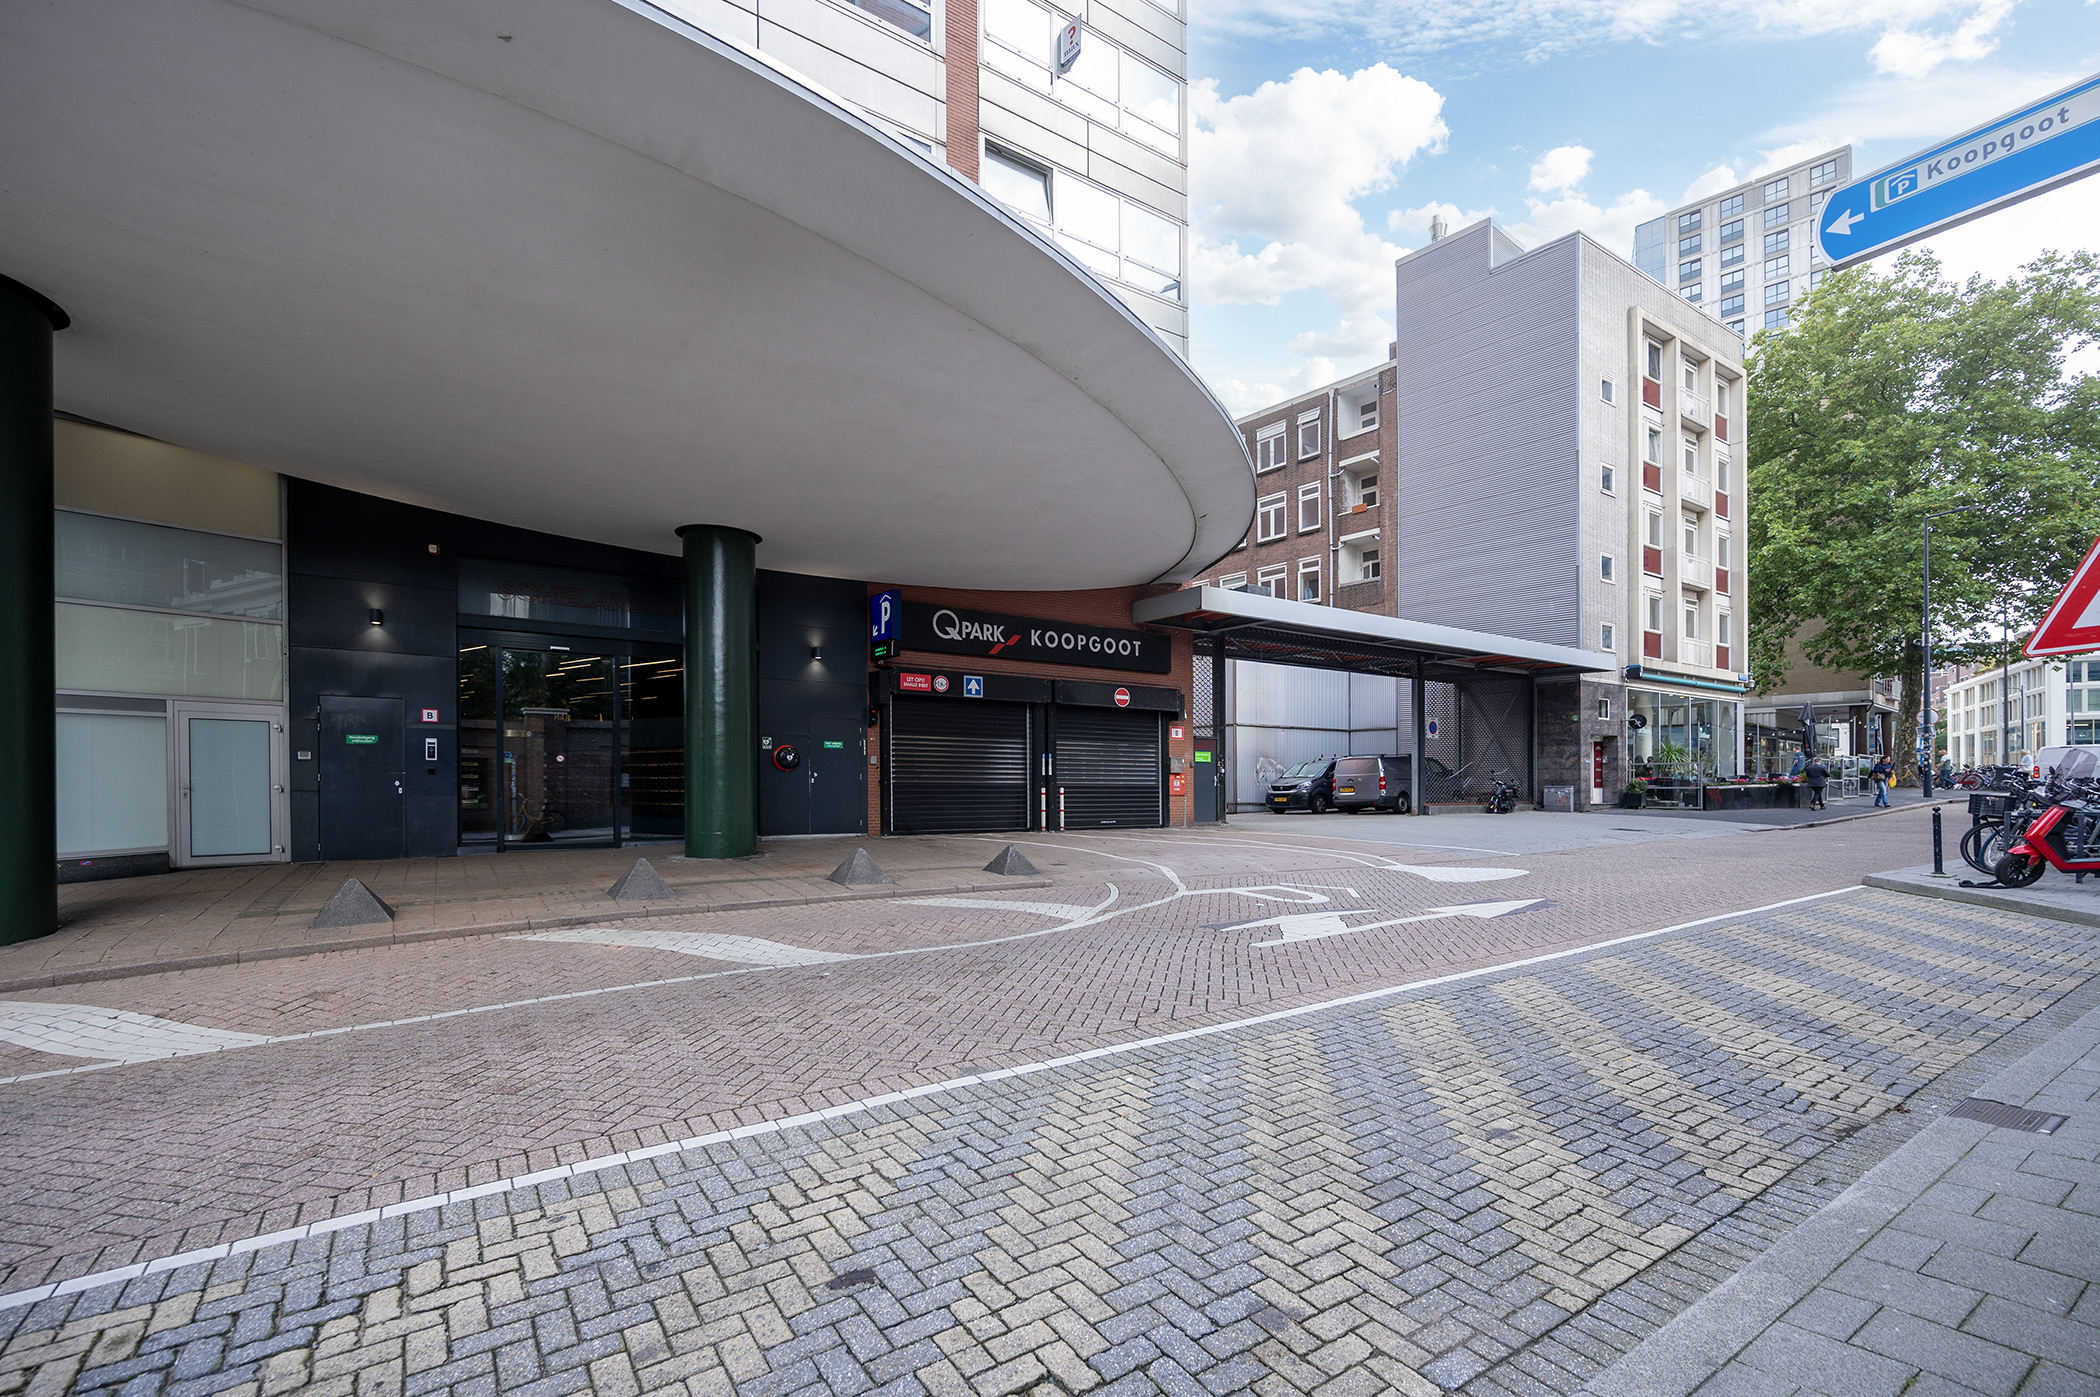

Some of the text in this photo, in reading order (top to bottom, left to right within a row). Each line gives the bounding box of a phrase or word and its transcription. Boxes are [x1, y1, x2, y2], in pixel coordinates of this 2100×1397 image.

[1898, 106, 2070, 195] P Koopgoot
[497, 579, 682, 618] SCHIELANDTO
[881, 601, 891, 634] P
[1030, 629, 1142, 657] KOOPGOOT
[427, 711, 434, 719] B
